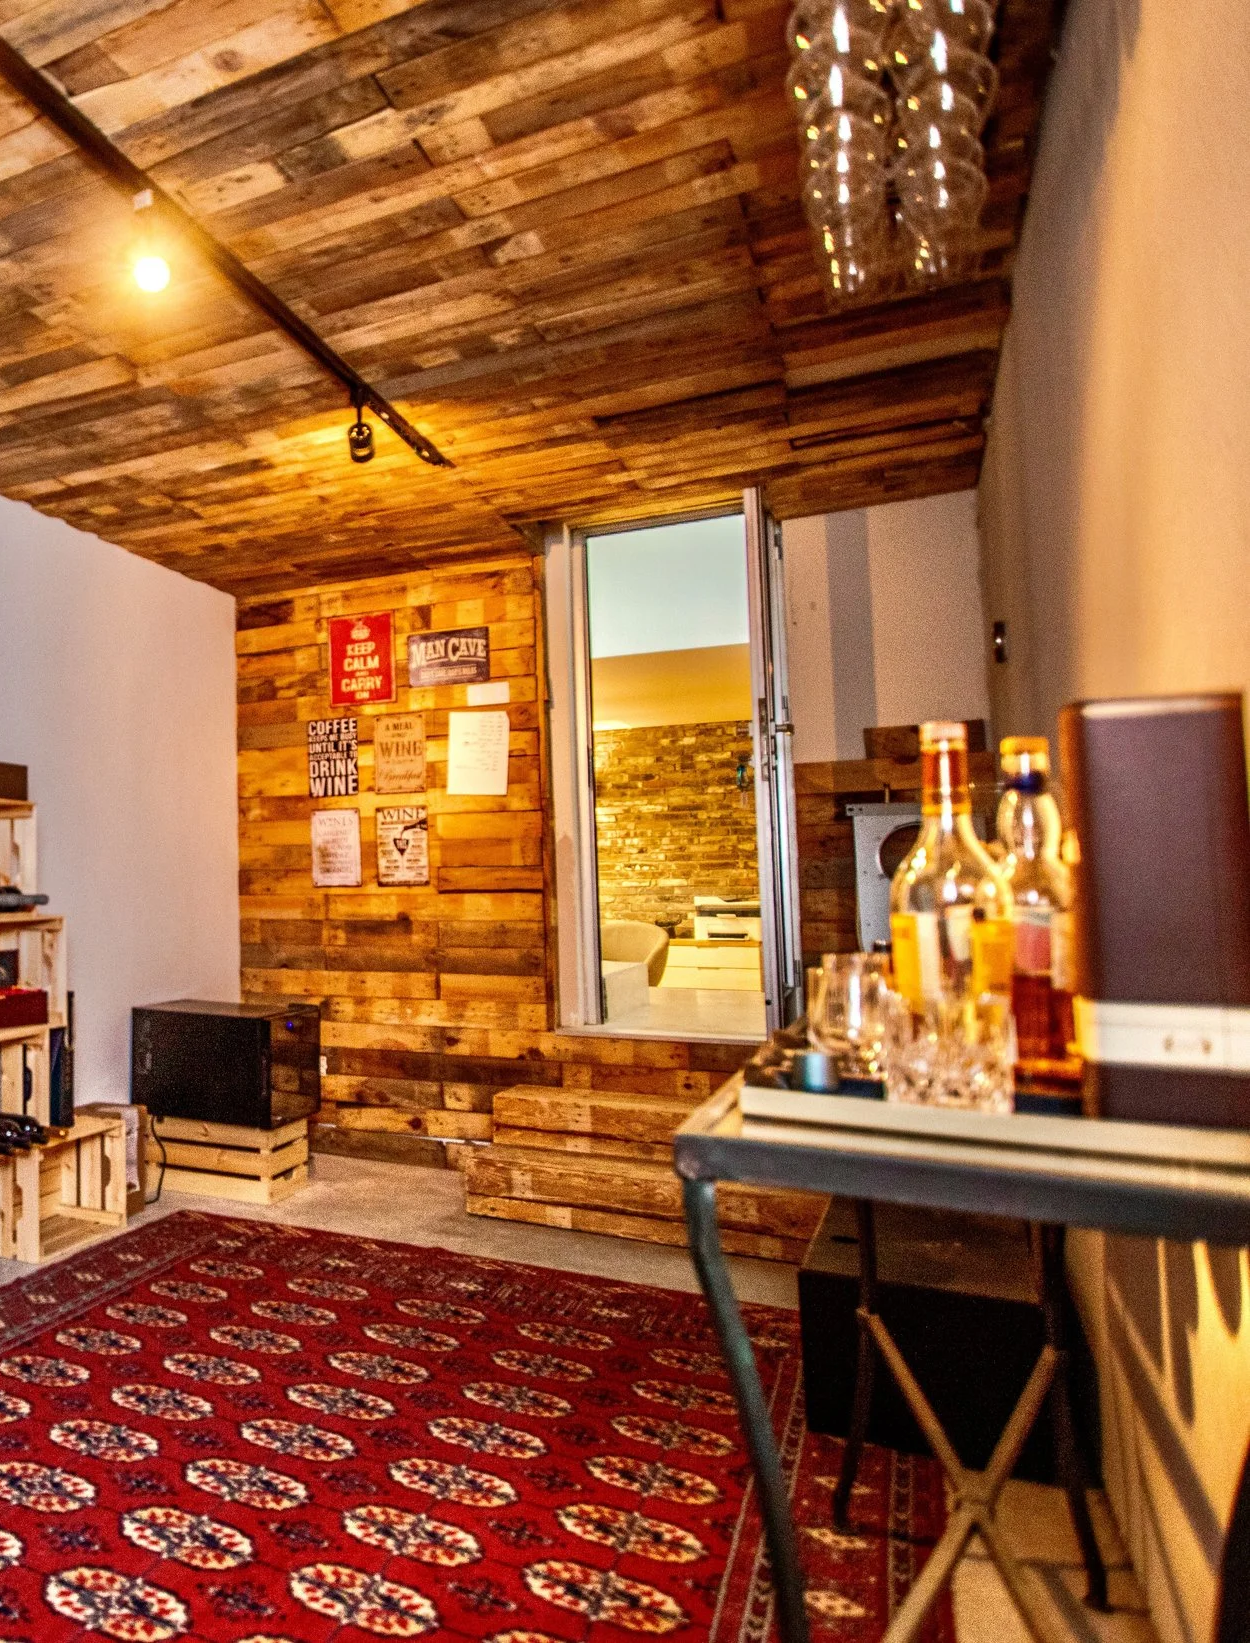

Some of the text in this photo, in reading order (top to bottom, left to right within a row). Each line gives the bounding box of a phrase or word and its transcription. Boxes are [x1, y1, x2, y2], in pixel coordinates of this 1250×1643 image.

[346, 641, 375, 655] KEEP
[411, 638, 486, 668] MAN CAVE
[343, 655, 379, 671] CALM
[341, 676, 382, 691] CARRY
[355, 691, 369, 699] ON
[309, 718, 357, 735] COFFEE
[309, 739, 358, 754] UNTIL IT'S
[380, 741, 422, 757] WINE
[309, 758, 358, 778] DRINK
[310, 775, 358, 796] WINE
